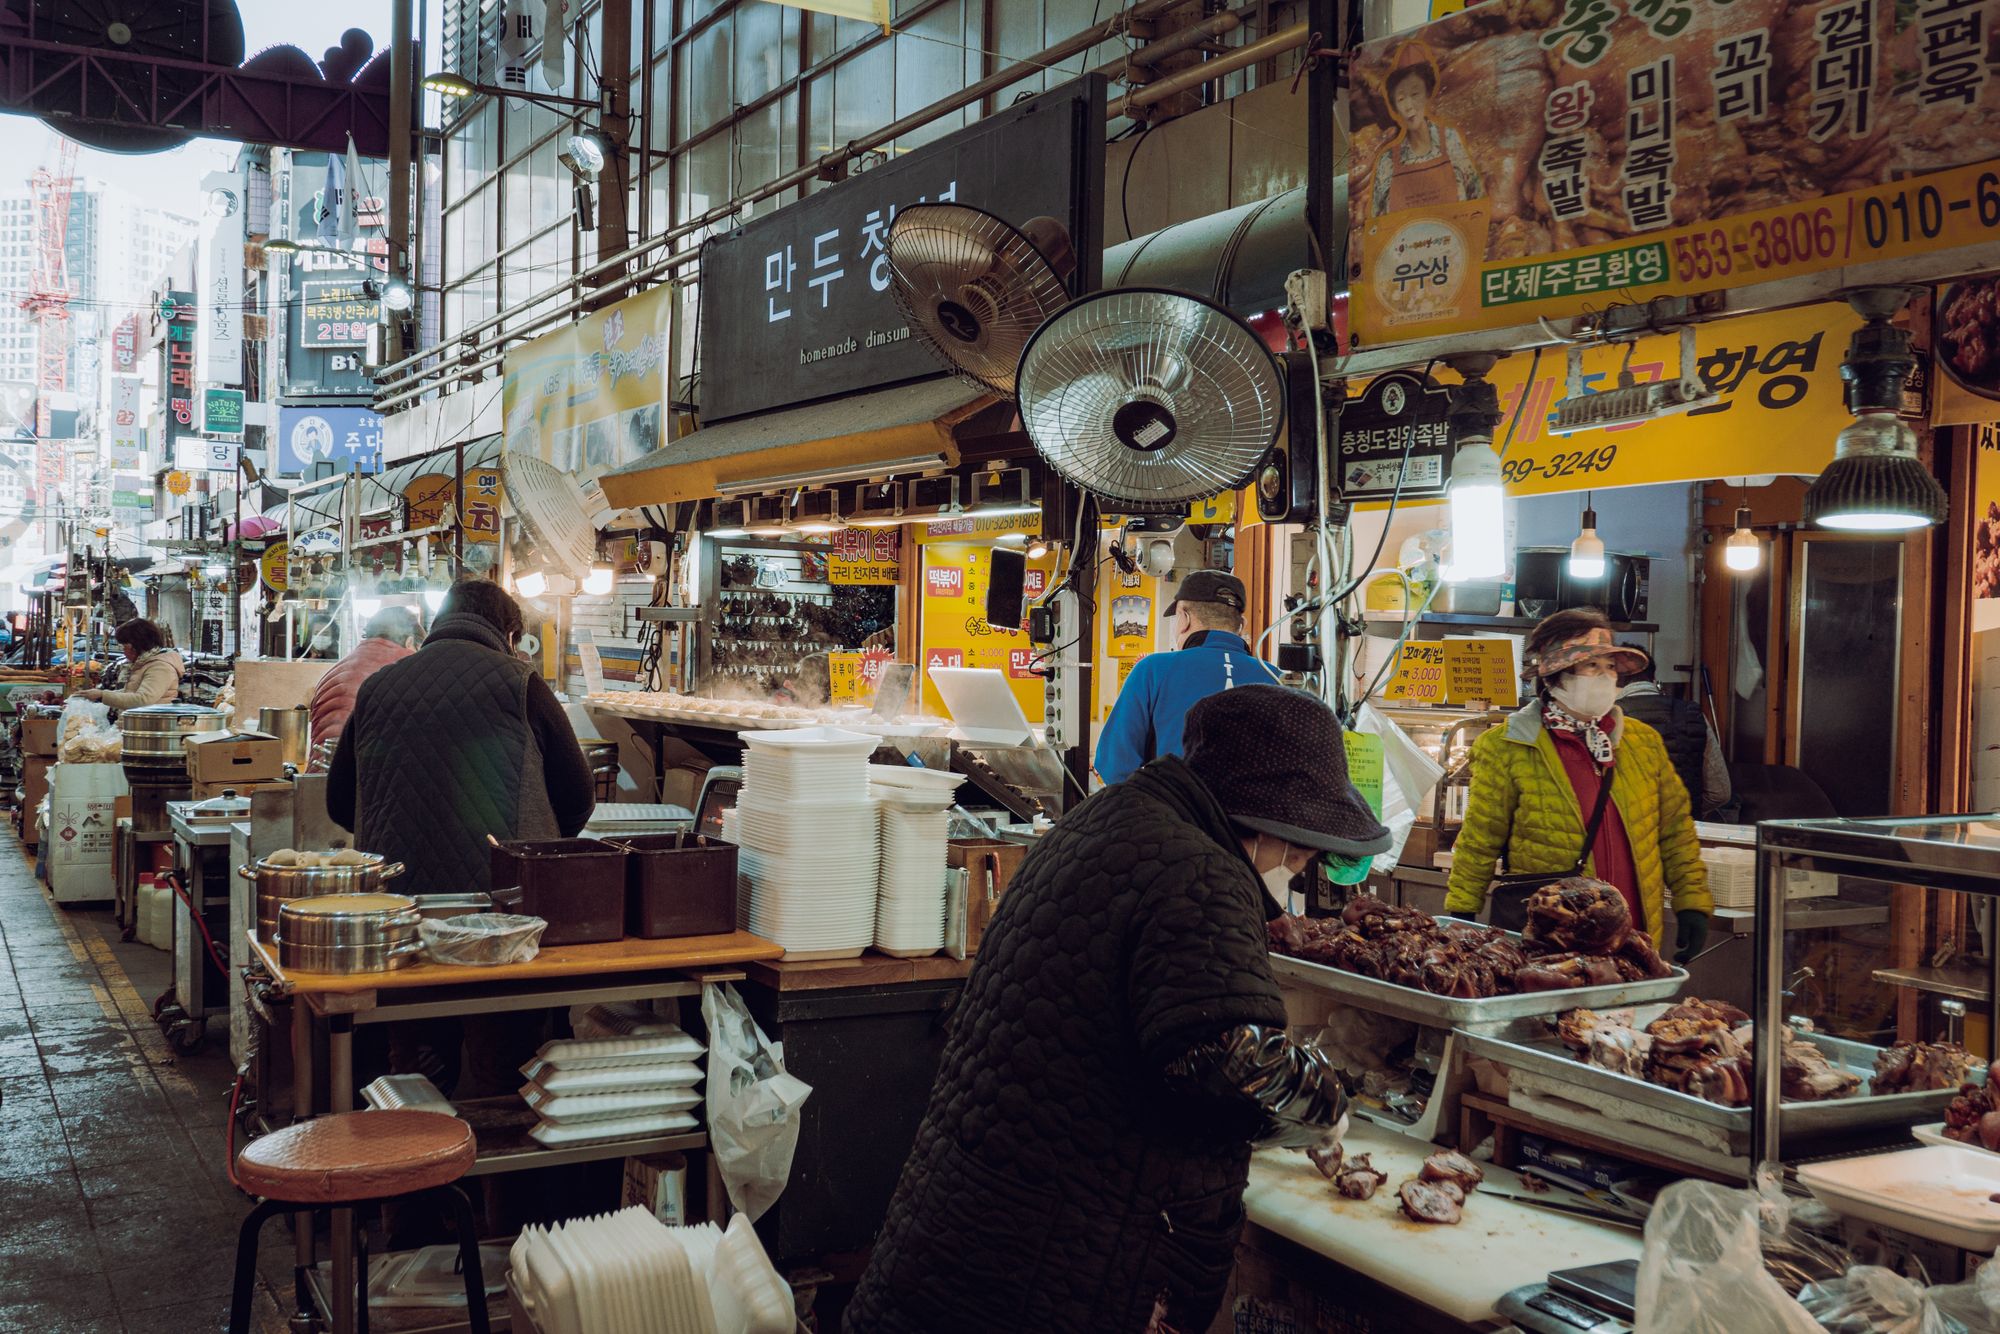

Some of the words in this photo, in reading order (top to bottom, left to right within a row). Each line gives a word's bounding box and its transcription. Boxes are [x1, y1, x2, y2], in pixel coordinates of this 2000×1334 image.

[1714, 33, 1767, 118] 꼬리
[1814, 0, 1873, 137] 껍데기
[1542, 84, 1590, 218] 왕족발
[1624, 59, 1674, 227] 미니족발
[1392, 255, 1449, 292] 우수상
[1485, 246, 1663, 304] 단체주문환영
[317, 322, 367, 341] 2만원
[865, 325, 910, 349] dimsum
[800, 337, 857, 365] homemade
[1686, 331, 1825, 417] 환영
[1341, 421, 1450, 455] 충청도집왕족발
[832, 528, 872, 562] 떡볶이
[832, 566, 851, 580] 구리
[853, 566, 880, 580] 전지역
[929, 569, 961, 588] 떡볶이
[1403, 646, 1443, 664] 꼬마김밥
[1411, 667, 1441, 680] 3,000
[1407, 684, 1438, 698] 5,000
